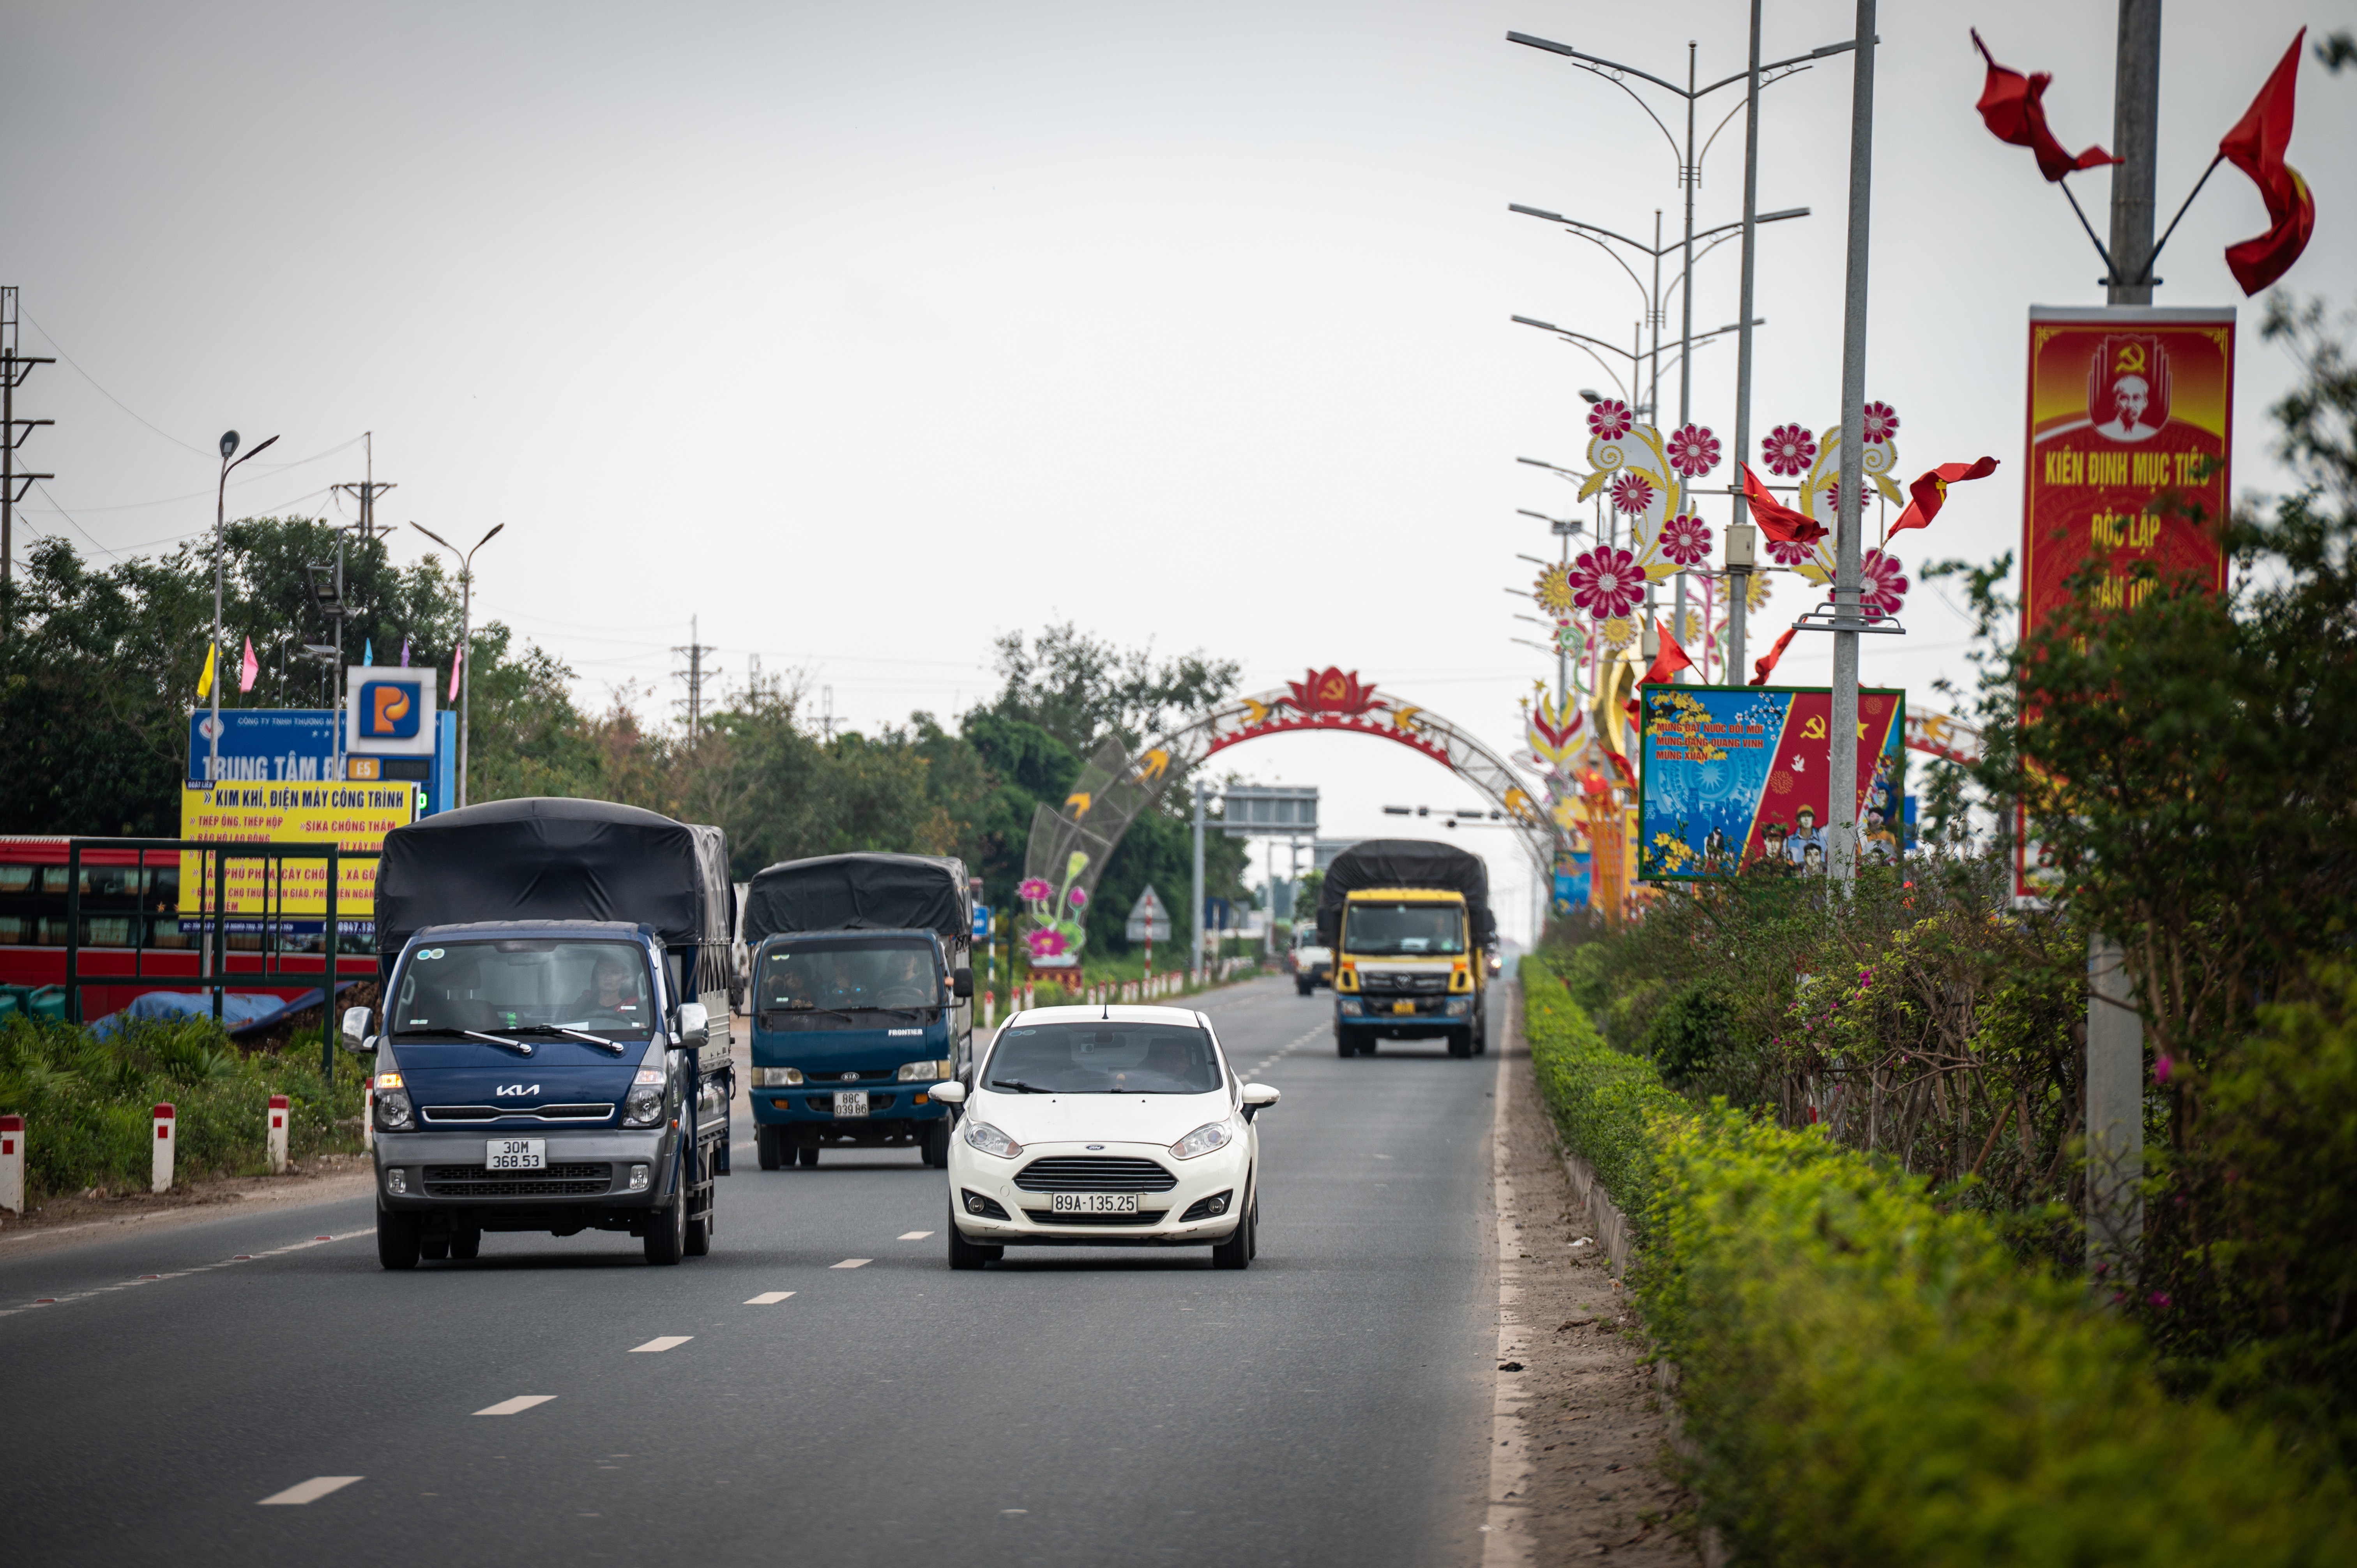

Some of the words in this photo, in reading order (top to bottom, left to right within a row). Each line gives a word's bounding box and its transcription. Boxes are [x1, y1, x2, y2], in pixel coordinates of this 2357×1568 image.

[2045, 445, 2083, 485] KIÊN
[2088, 451, 2128, 493] ĐỊNH
[2133, 452, 2170, 493] MỤC
[2129, 508, 2161, 555] LẬP
[238, 716, 258, 725] CÔNG
[1711, 738, 1740, 748] QUANG
[1743, 739, 1764, 748] VINH
[203, 756, 268, 780] TRUNG
[274, 750, 317, 780] TÂM
[357, 762, 371, 776] E5
[216, 789, 239, 806] KIM
[242, 786, 267, 809] KHÍ,
[270, 786, 299, 812] ĐIỆN
[302, 786, 329, 807] MÁY
[332, 787, 365, 807] CÔNG
[368, 787, 404, 808] TRÌNH
[198, 814, 219, 826] THÉP
[244, 814, 264, 827] THÉP
[266, 815, 283, 829] HỘP
[306, 820, 328, 831] SIKA
[331, 817, 365, 832] CHỐNG
[282, 866, 301, 879] CÂY
[305, 865, 343, 881] CHỐ,
[346, 867, 359, 879] XÀ
[228, 887, 244, 897] CHO
[269, 888, 288, 897] GIN
[337, 886, 350, 900] IỆN
[353, 887, 374, 898] NGÀN
[496, 1084, 539, 1096] KIA
[843, 1093, 859, 1104] 88C
[504, 1141, 528, 1153] 30M
[493, 1155, 539, 1167] 368.53
[1056, 1195, 1134, 1211] 89A-135.25
